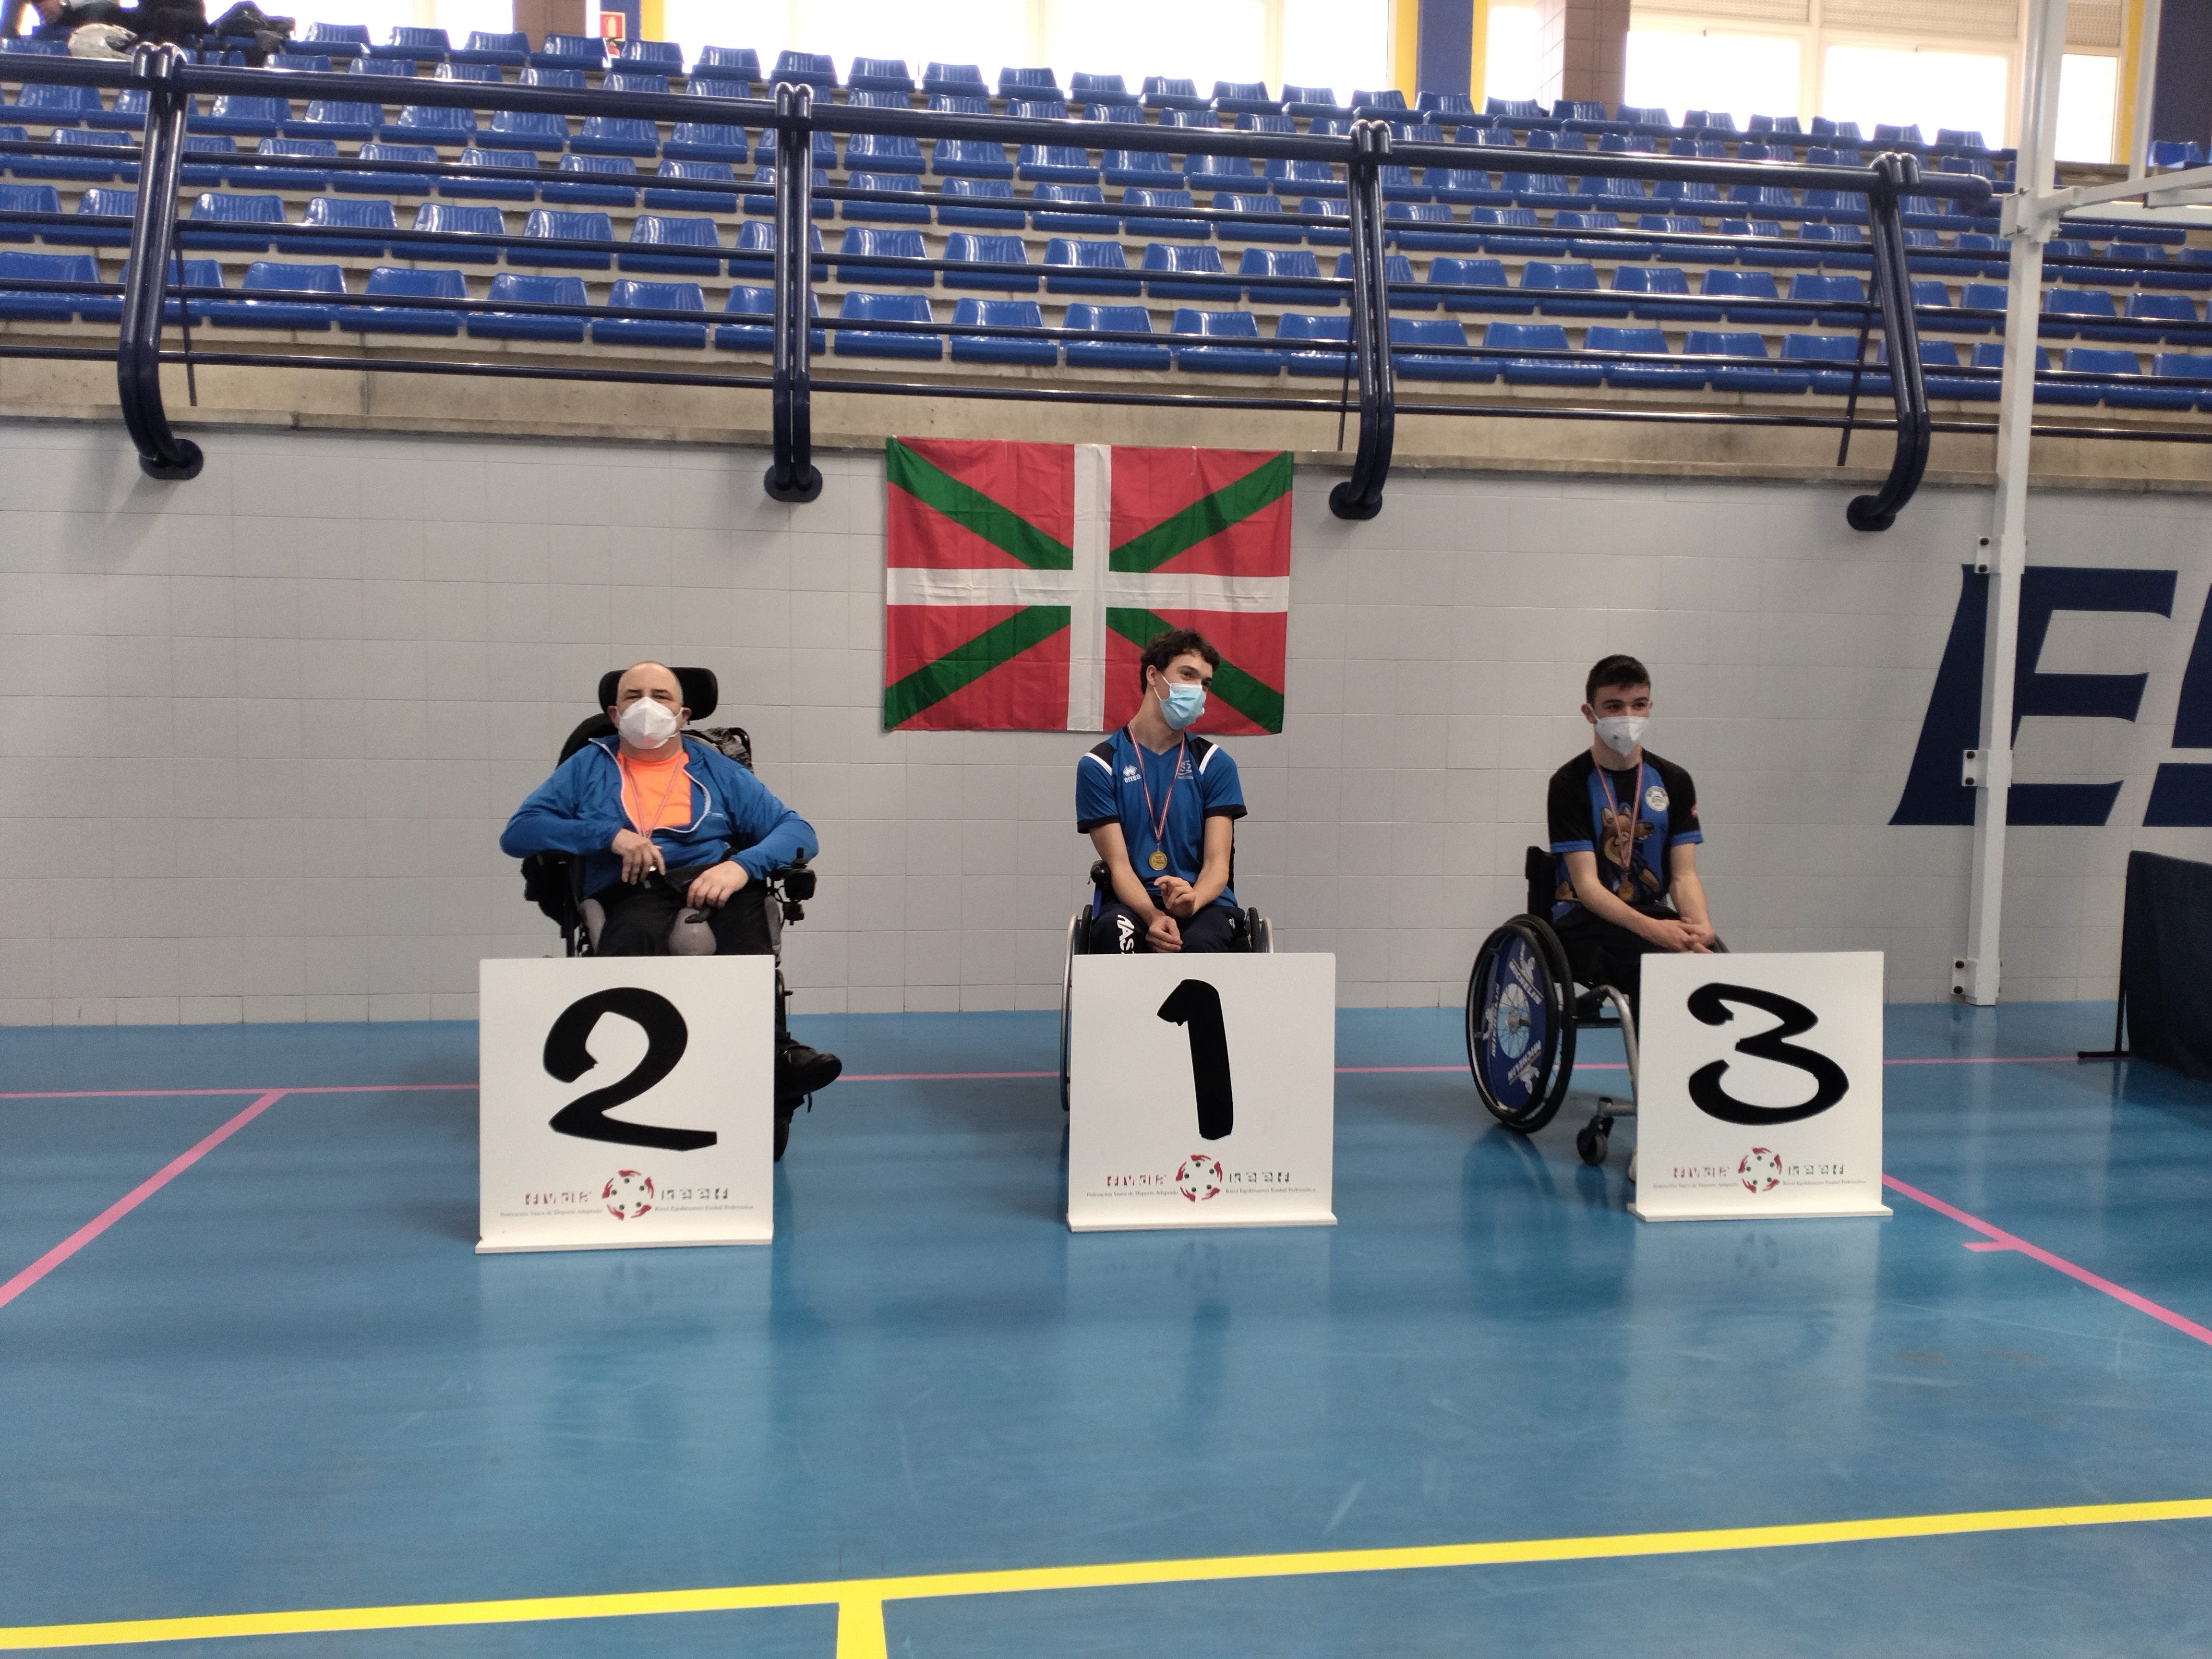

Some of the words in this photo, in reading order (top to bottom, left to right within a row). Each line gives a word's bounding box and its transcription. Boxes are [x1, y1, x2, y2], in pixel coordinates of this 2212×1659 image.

[1888, 564, 2212, 827] E
[543, 987, 717, 1151] 2
[1157, 979, 1233, 1140] 1
[1687, 982, 1850, 1126] 3
